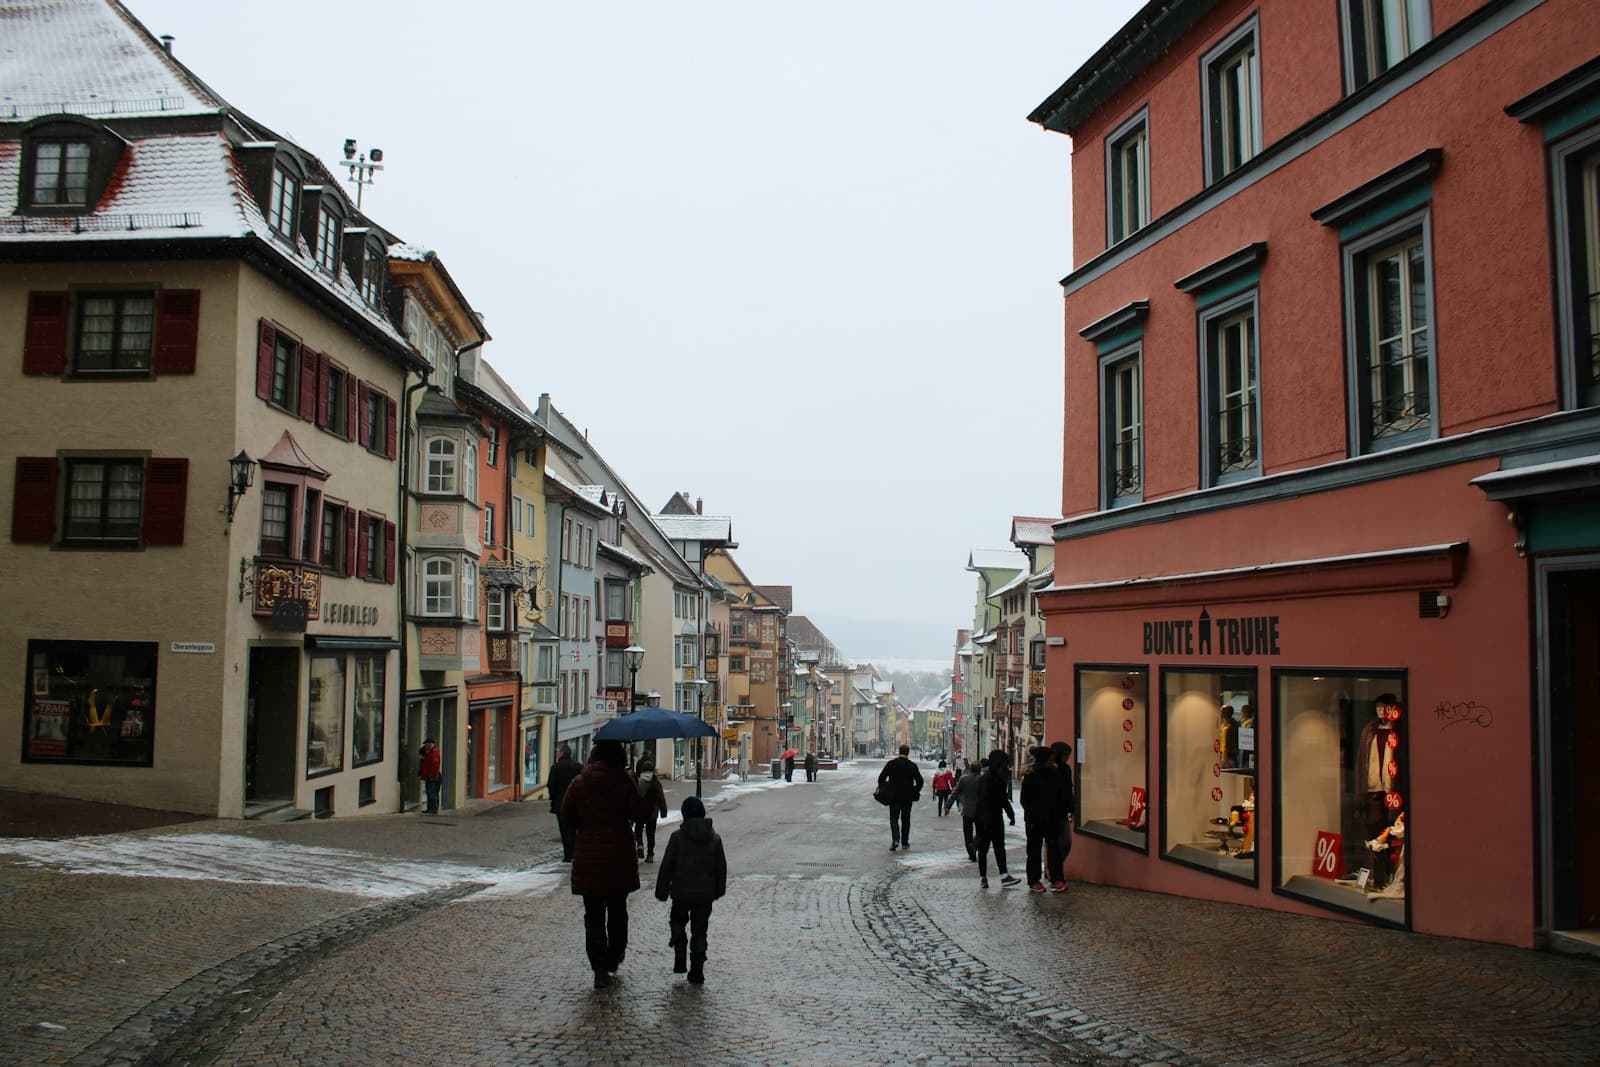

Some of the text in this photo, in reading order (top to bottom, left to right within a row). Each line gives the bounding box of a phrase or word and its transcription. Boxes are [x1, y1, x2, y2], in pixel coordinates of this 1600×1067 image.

[1143, 615, 1281, 656] BUNTE TRUHE
[1317, 837, 1336, 873] %
